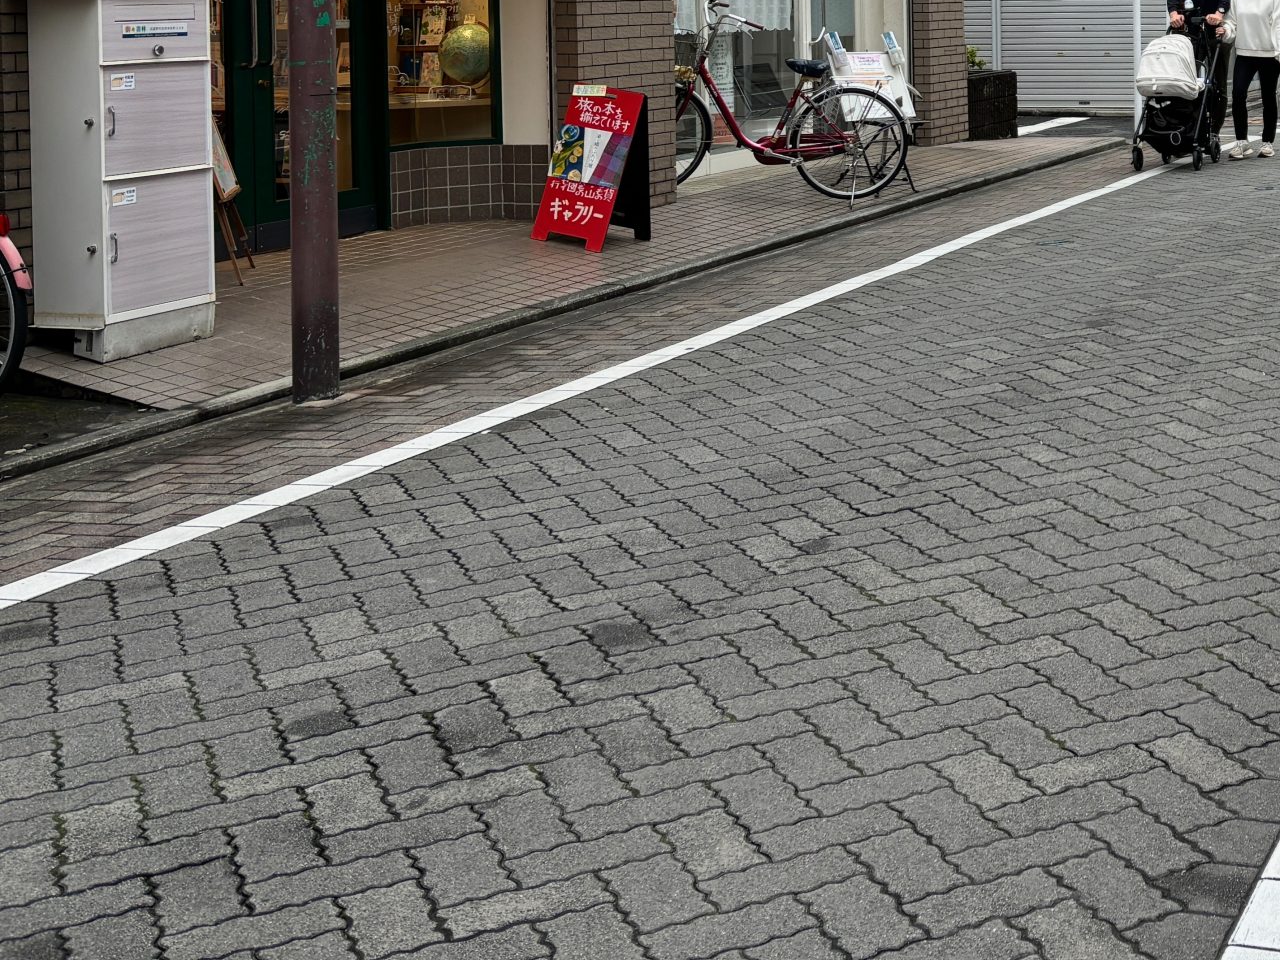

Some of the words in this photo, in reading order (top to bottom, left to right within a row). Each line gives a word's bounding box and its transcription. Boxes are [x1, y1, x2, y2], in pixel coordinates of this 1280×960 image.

[575, 97, 623, 122] 旅の本を
[579, 111, 631, 133] 揃えています
[549, 197, 604, 225] ギャラリー
